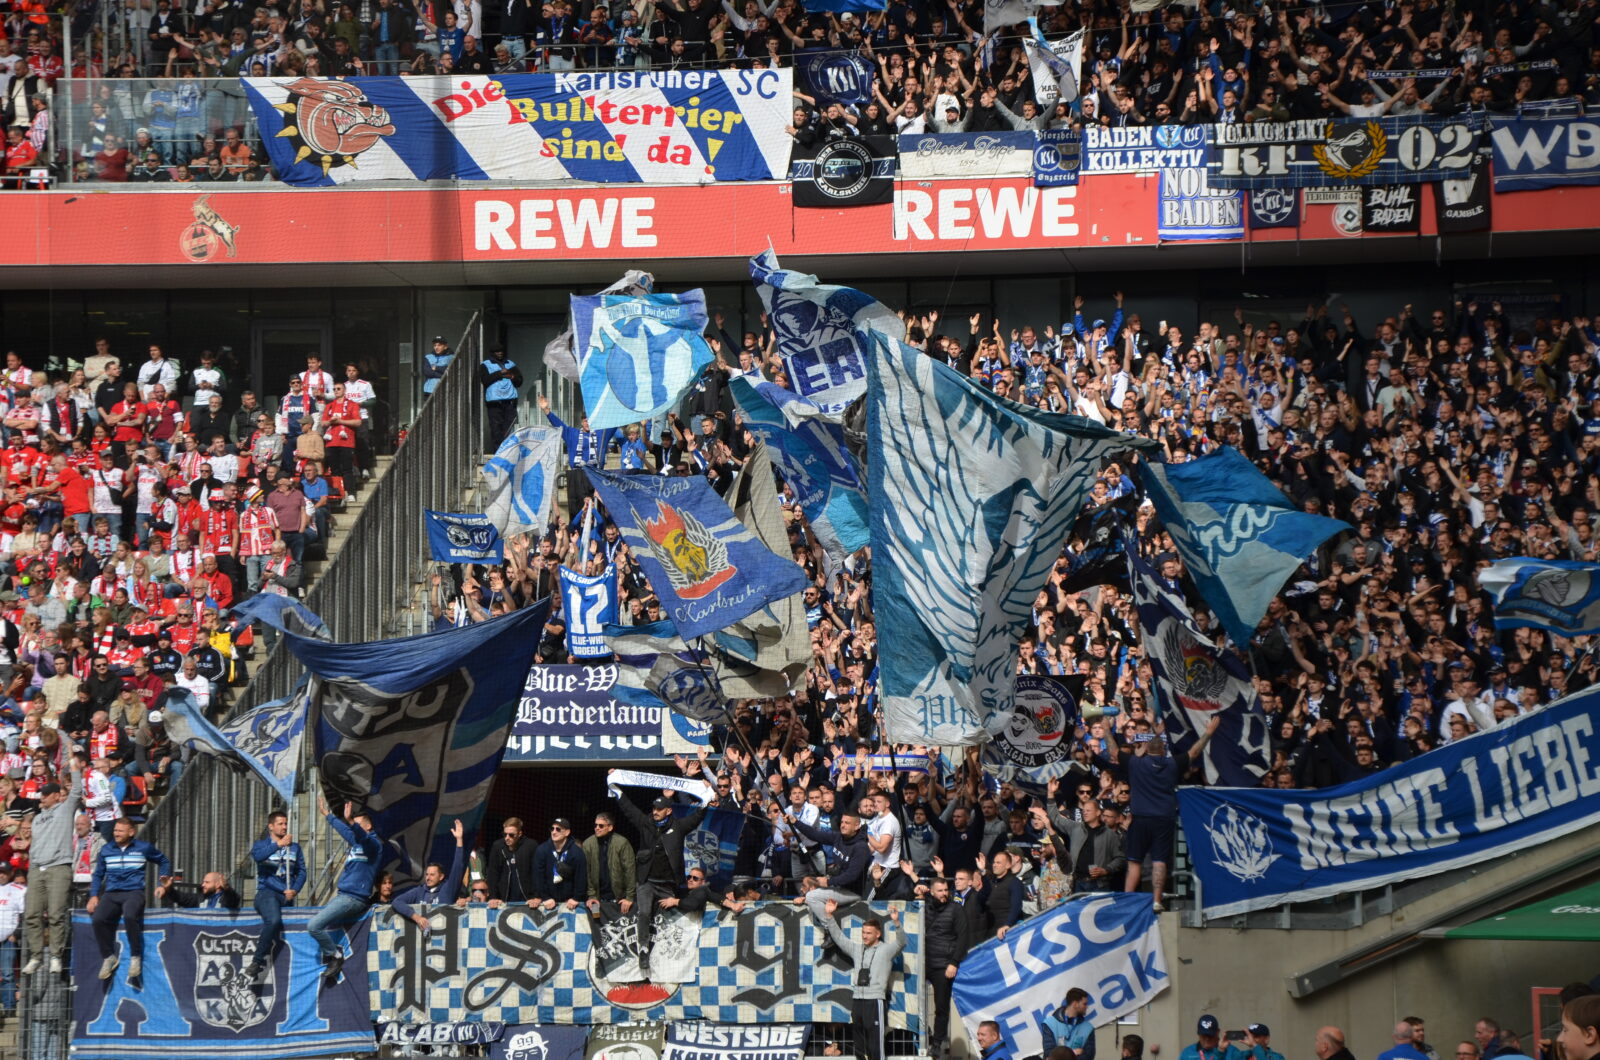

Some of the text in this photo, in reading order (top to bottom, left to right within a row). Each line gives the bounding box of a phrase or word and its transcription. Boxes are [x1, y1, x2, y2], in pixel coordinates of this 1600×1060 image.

[737, 69, 780, 99] SC
[432, 80, 506, 122] Die
[507, 96, 744, 134] Bullterrier
[540, 127, 626, 161] sind
[1086, 126, 1152, 148] BADEN
[1183, 126, 1200, 143] KSC
[1215, 118, 1327, 145] VOLLKONTAKT
[915, 137, 967, 157] Blood
[1040, 151, 1056, 166] KSC
[1088, 149, 1203, 171] KOLLEKTIV
[1398, 125, 1474, 171] 02
[797, 161, 812, 177] 20
[816, 176, 868, 197] KARLSRUHE
[474, 197, 657, 250] REWE
[893, 186, 1080, 240] REWE
[1163, 199, 1240, 227] BADEN
[1368, 203, 1414, 226] BADEN
[567, 583, 609, 635] 12
[1283, 713, 1600, 871] MEINE LIEBE
[994, 896, 1127, 988] KSC
[380, 1021, 451, 1043] ACAB
[457, 1023, 476, 1041] KSC
[516, 1036, 534, 1048] 99
[675, 1024, 804, 1048] WESTSIDE
